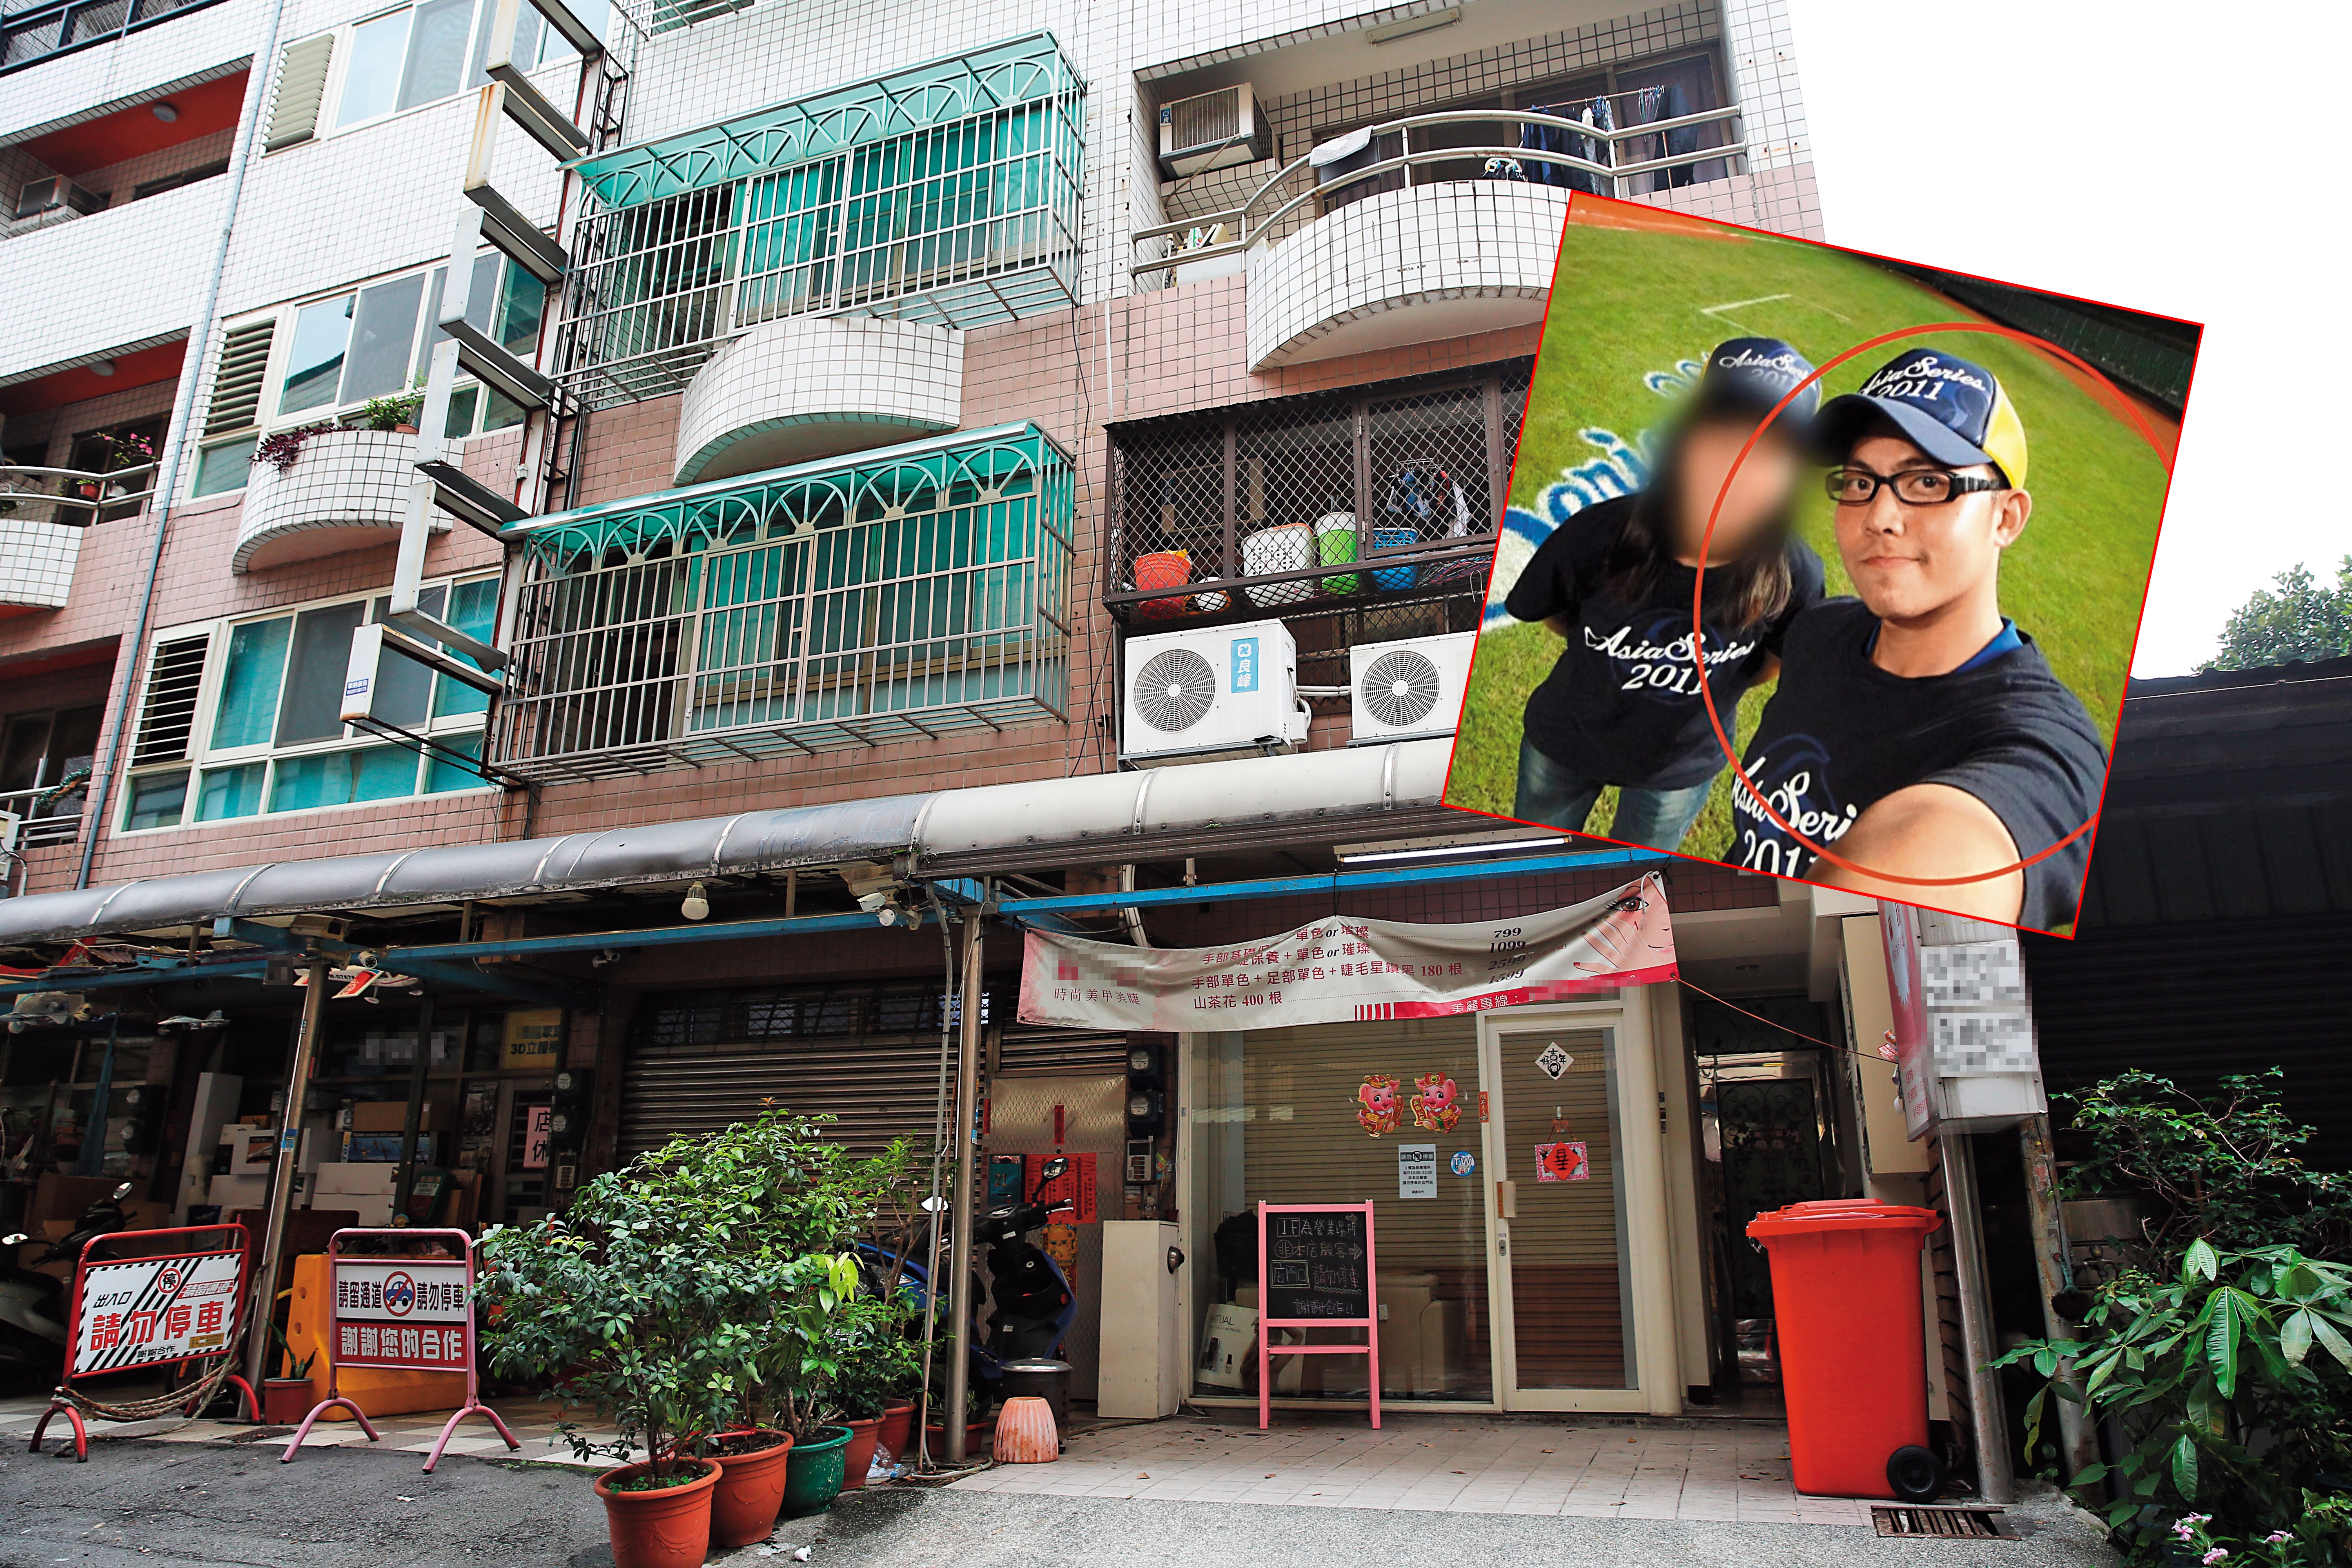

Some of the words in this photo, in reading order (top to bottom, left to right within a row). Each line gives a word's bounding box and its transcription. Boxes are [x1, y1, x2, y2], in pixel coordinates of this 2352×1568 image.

[1236, 659, 1252, 688] 良峰
[1742, 829, 1820, 878] 201
[1326, 927, 1339, 938] or
[1494, 927, 1521, 938] 799
[1296, 947, 1325, 961] 單色
[1327, 948, 1340, 958] or
[1490, 940, 1526, 953] 1099
[1191, 973, 1250, 989] 手部單色
[1267, 967, 1325, 985] 足部單色
[1421, 964, 1443, 976] 180
[1448, 962, 1463, 975] 根
[1488, 955, 1526, 971] 2599
[1054, 987, 1141, 1005] 時尚美甲美睫
[1194, 994, 1237, 1010] 山茶花
[1242, 994, 1264, 1006] 400
[1269, 991, 1282, 1005] 根
[1488, 968, 1525, 984] 1599
[1453, 1157, 1472, 1165] TW
[994, 1173, 1007, 1187] 21
[1273, 1262, 1306, 1283] 店門口
[1312, 1263, 1360, 1288] 請勿停車
[93, 1291, 133, 1308] 出入口
[182, 1280, 232, 1298] 請留通道
[339, 1281, 382, 1309] 請留通道
[416, 1281, 464, 1312] 請勿停車
[90, 1301, 224, 1351] 請勿停車
[136, 1345, 176, 1359] 謝謝合作
[341, 1326, 462, 1361] 謝謝您的合作
